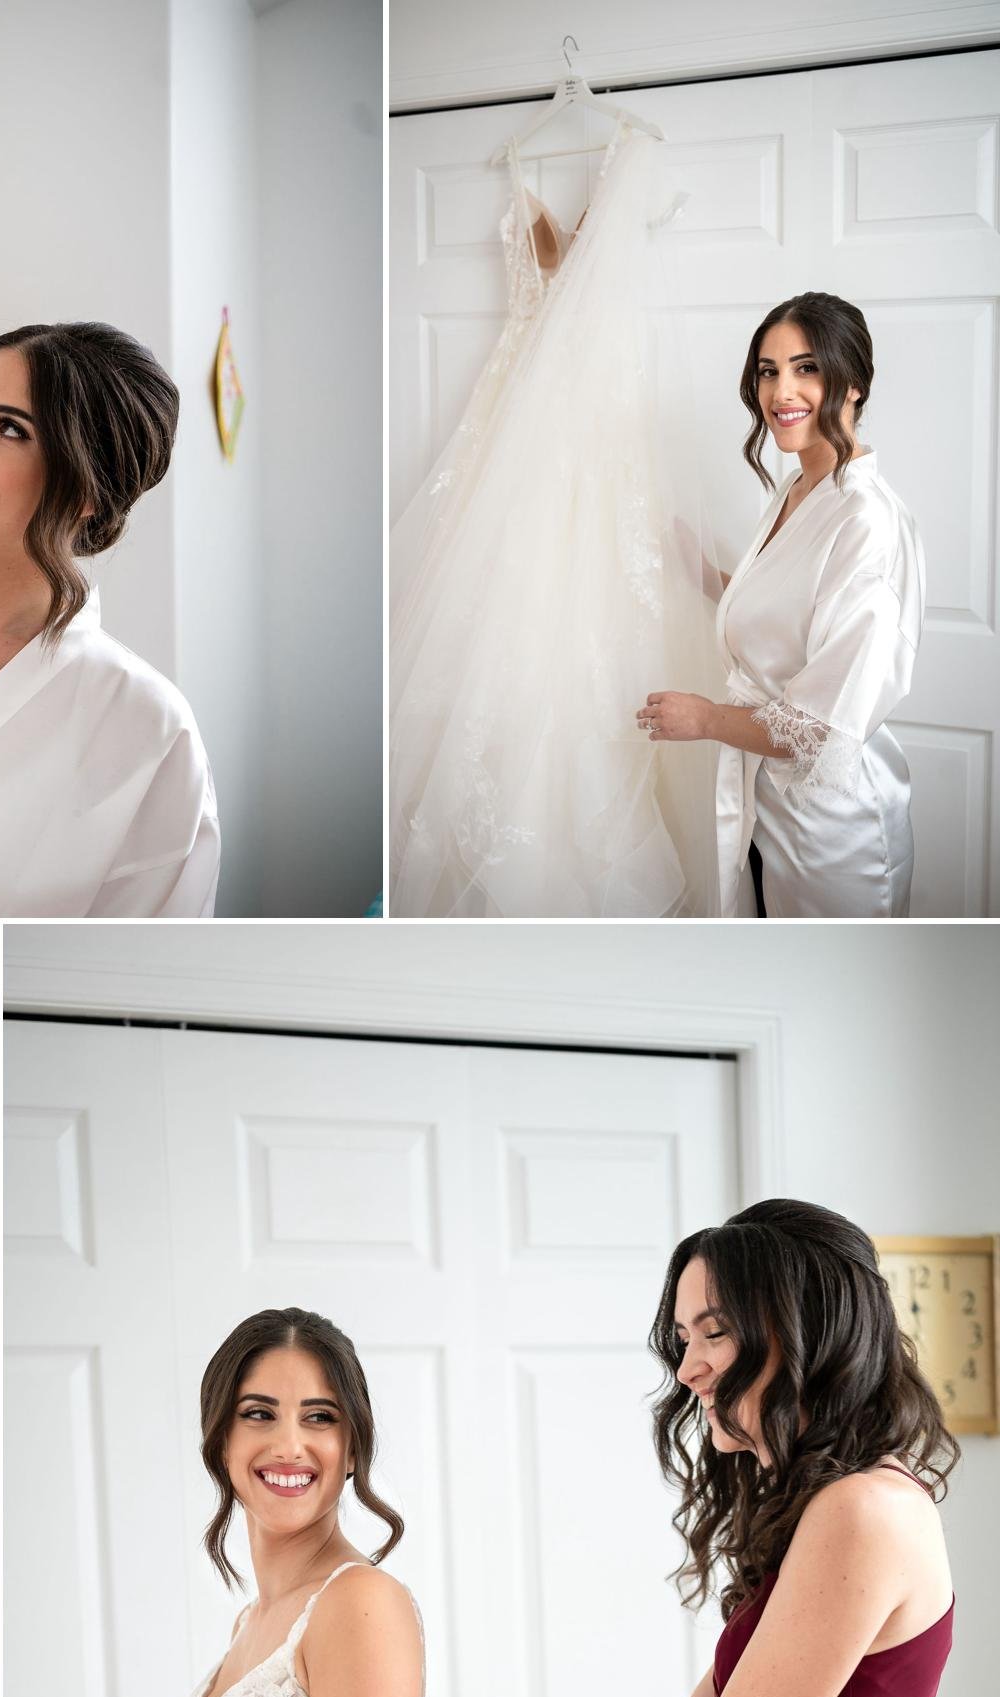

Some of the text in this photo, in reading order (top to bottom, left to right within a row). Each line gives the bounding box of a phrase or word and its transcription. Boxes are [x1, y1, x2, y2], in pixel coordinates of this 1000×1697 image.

[909, 1265, 930, 1289] 12
[942, 1269, 950, 1292] 1
[960, 1289, 976, 1316] 2
[968, 1321, 983, 1350] 3
[961, 1357, 977, 1381] 4
